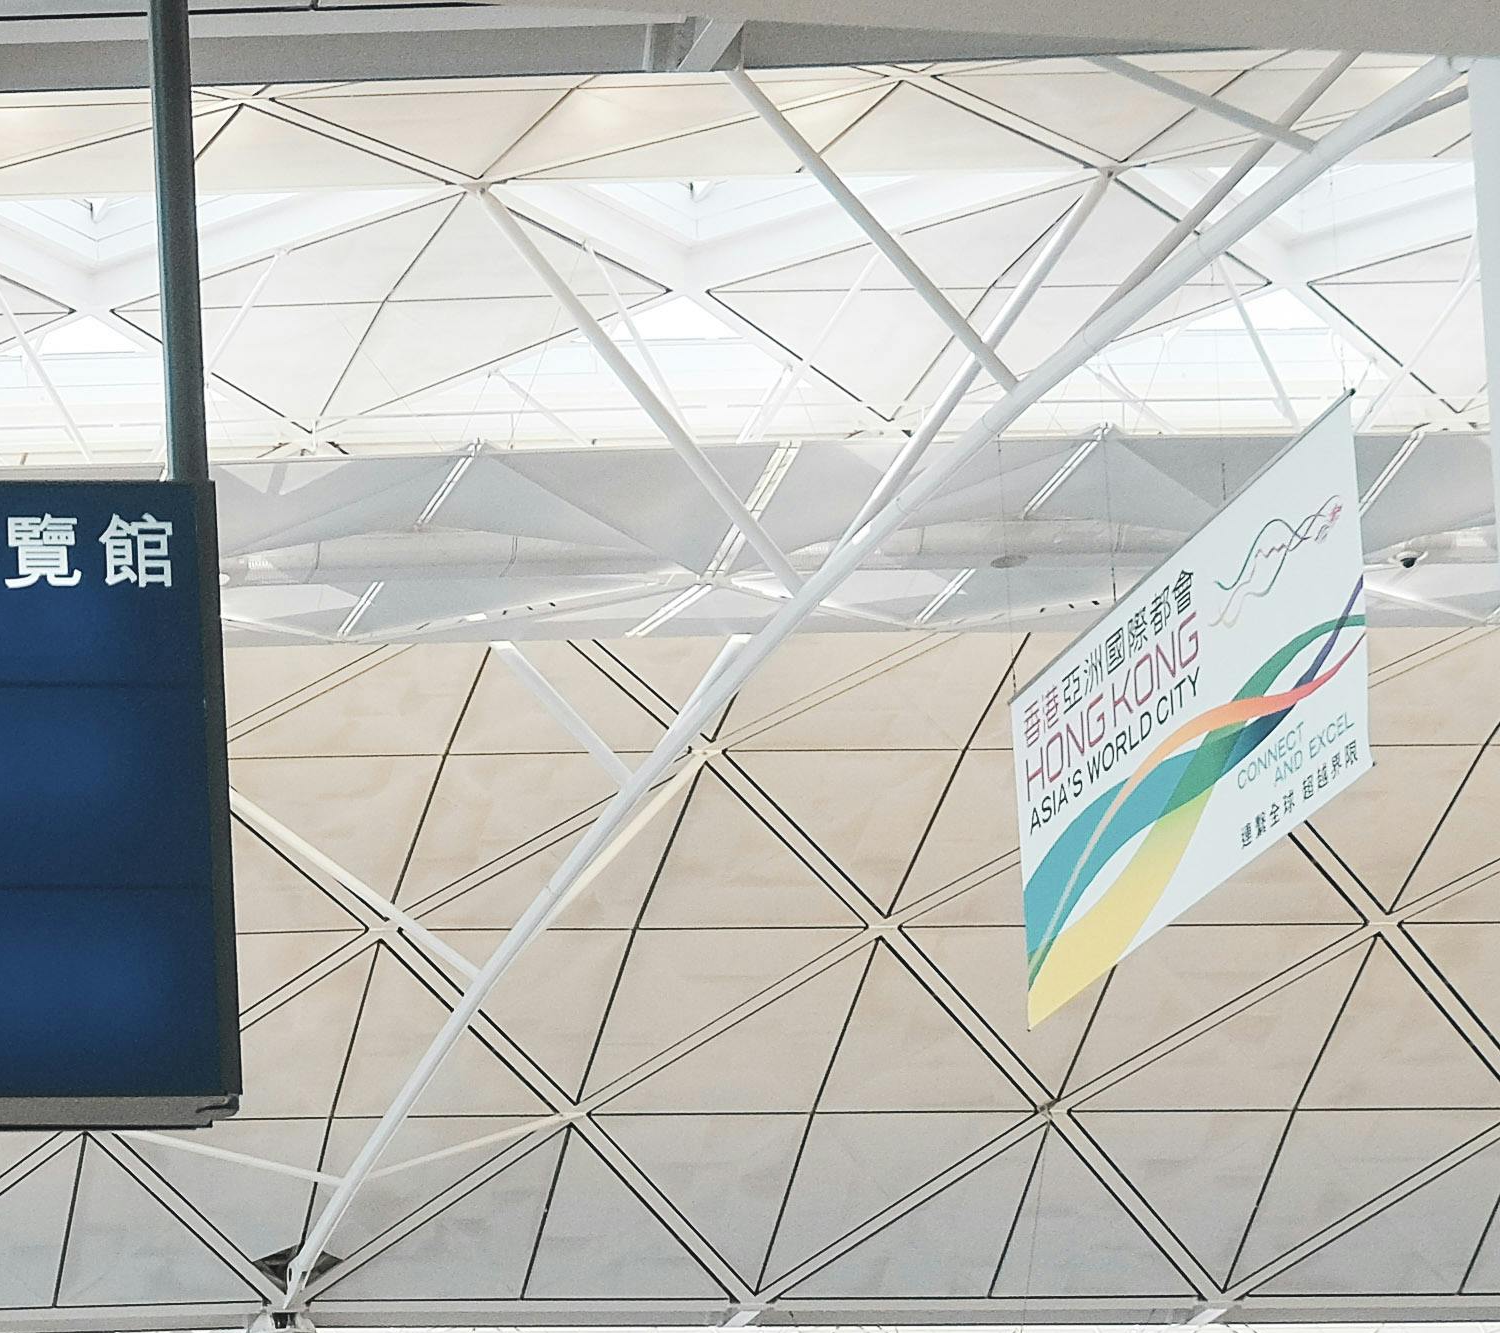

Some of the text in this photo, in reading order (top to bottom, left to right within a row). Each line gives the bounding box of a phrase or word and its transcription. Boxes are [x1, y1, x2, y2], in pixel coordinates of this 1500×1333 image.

[1026, 611, 1199, 802] HONG KONG
[1030, 666, 1200, 835] ASIA'S WORLD CITY
[1237, 721, 1304, 790] CONNECT
[1274, 711, 1356, 787] AND EXCEL
